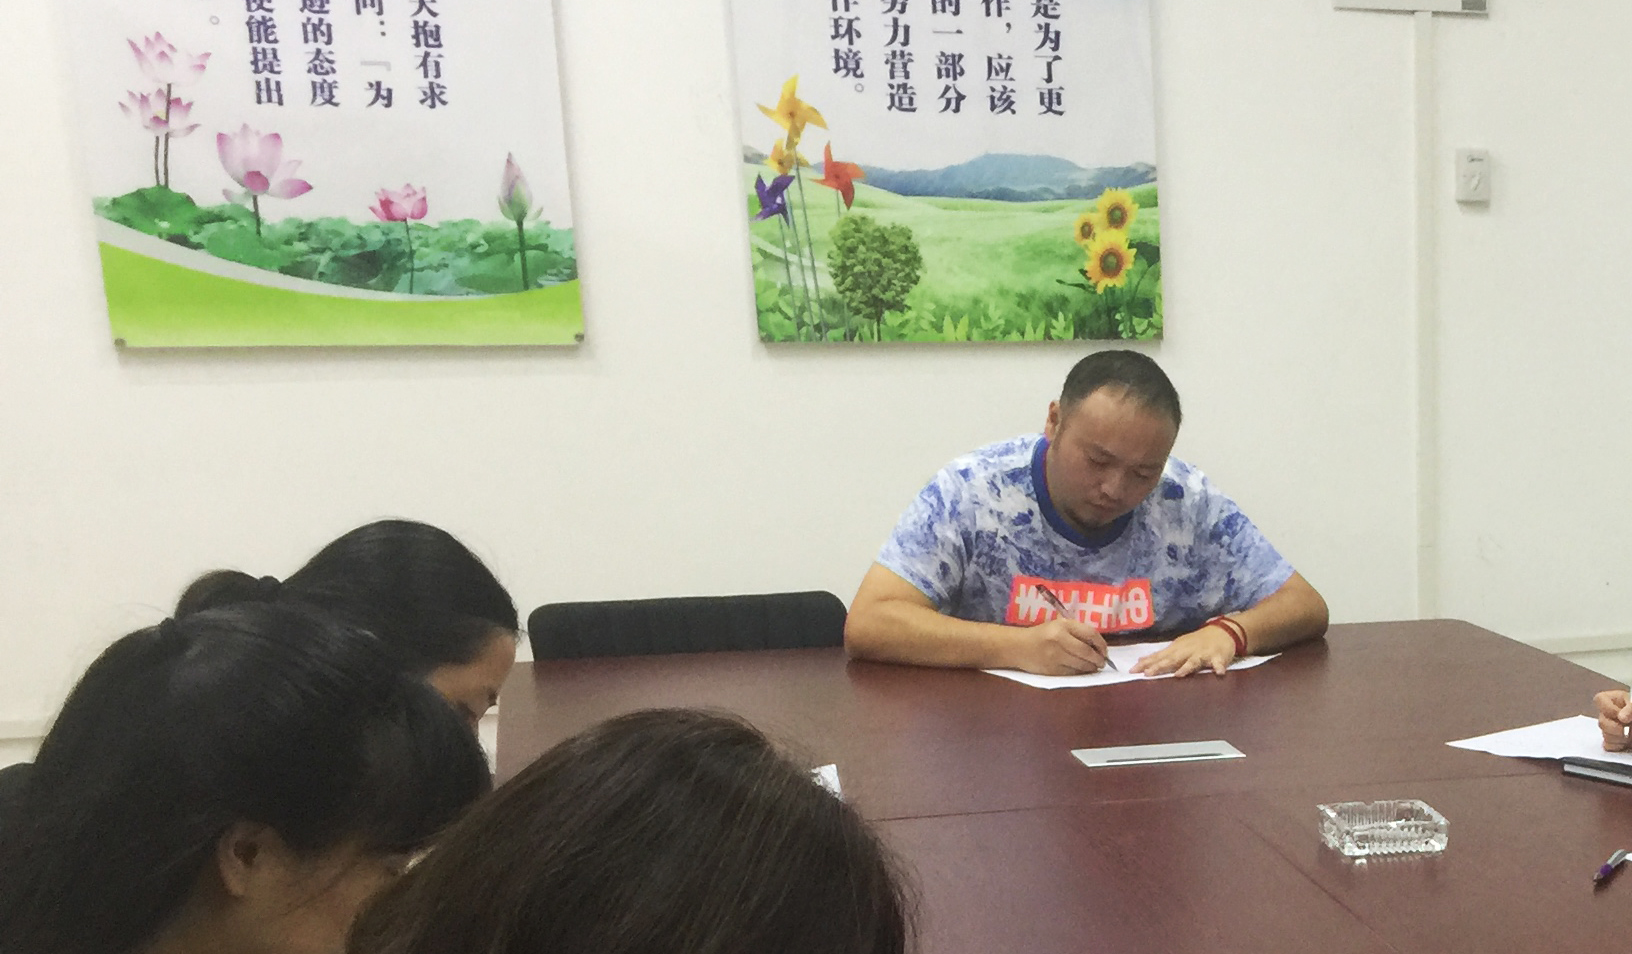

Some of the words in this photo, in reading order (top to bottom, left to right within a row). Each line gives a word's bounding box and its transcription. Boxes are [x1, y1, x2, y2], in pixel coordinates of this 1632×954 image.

[931, 0, 968, 115] 的一部分
[1031, 0, 1066, 117] 是为了更
